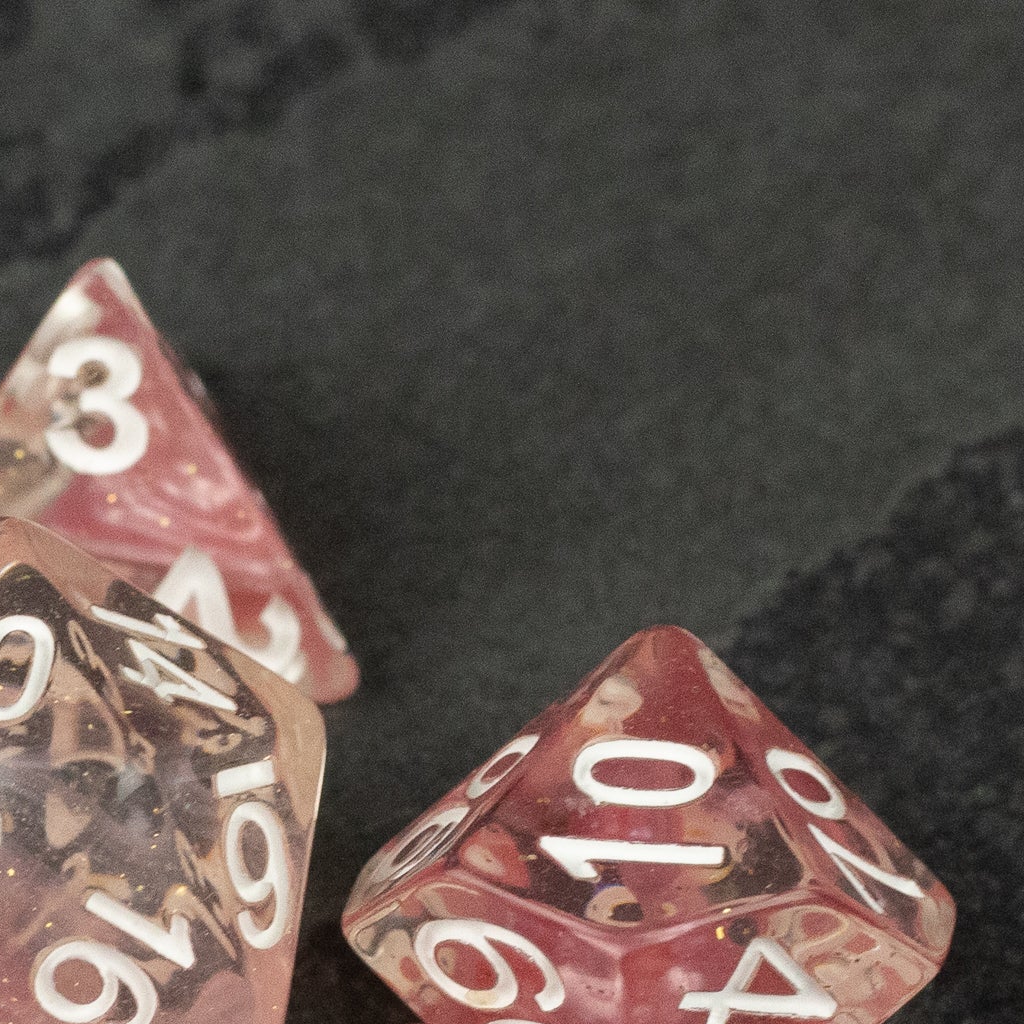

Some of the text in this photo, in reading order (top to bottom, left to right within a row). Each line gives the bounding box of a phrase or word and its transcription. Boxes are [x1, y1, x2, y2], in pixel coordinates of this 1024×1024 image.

[46, 336, 148, 475] 3
[539, 738, 728, 881] 10
[765, 747, 927, 915] 70
